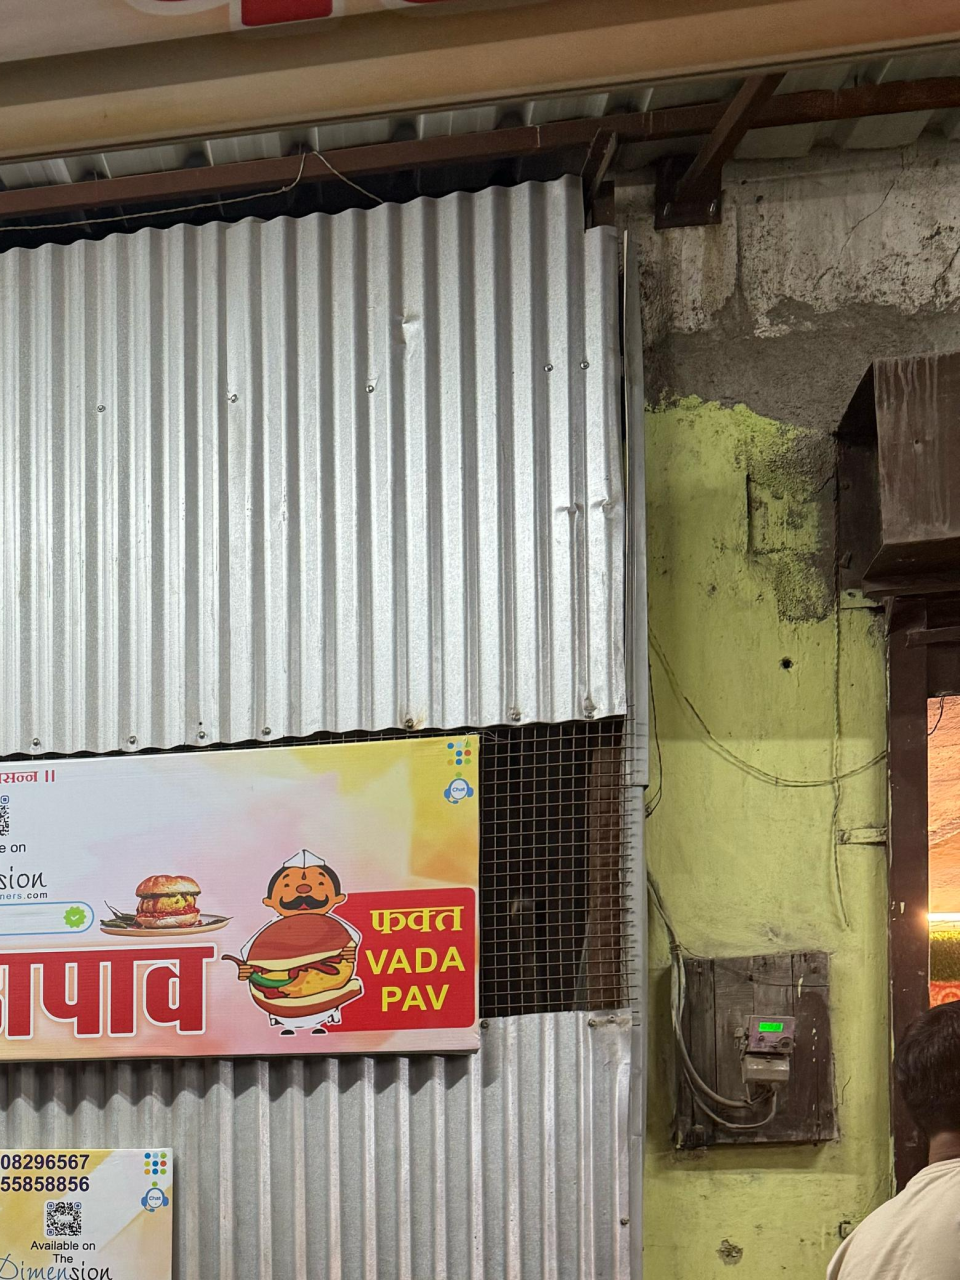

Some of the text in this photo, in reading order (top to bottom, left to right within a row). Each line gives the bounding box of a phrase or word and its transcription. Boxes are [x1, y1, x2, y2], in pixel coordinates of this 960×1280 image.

[10, 843, 27, 854] on
[369, 905, 465, 935] फक्त
[365, 946, 466, 975] VADA
[381, 984, 450, 1012] PAV
[30, 1240, 96, 1251] Available on
[52, 1253, 74, 1264] The
